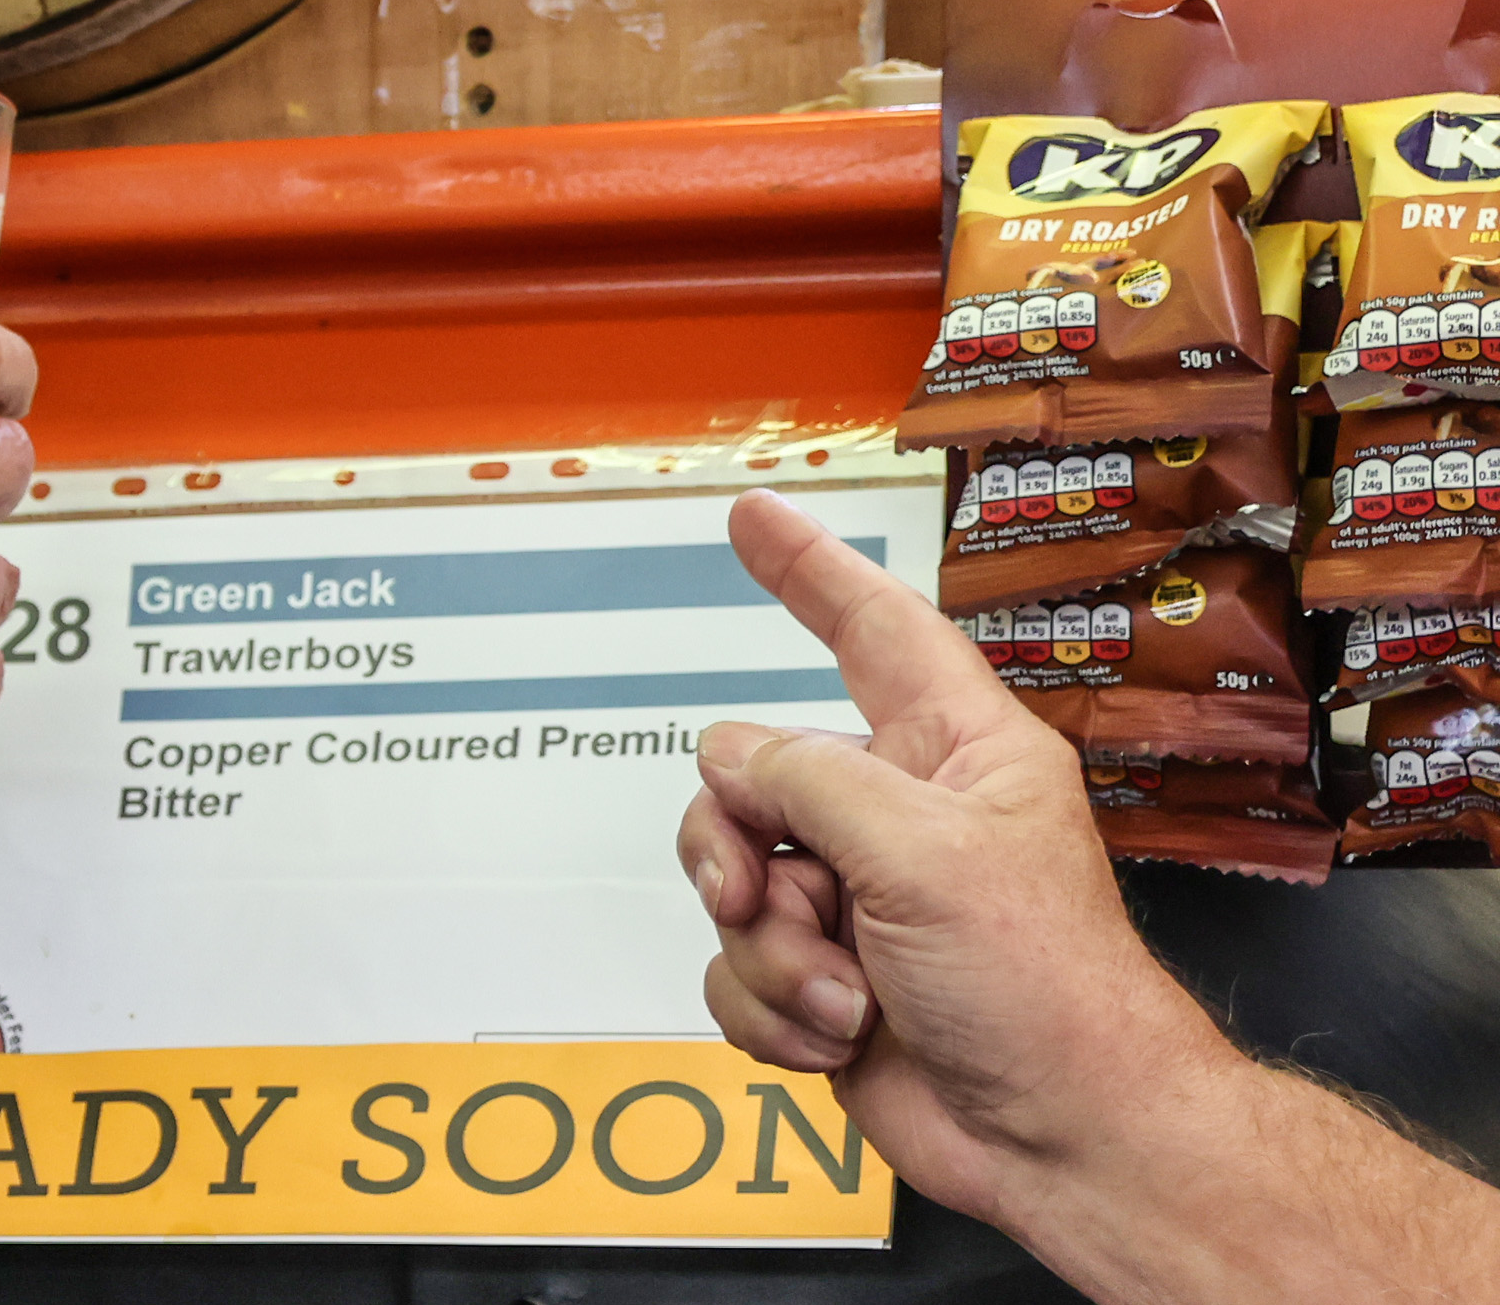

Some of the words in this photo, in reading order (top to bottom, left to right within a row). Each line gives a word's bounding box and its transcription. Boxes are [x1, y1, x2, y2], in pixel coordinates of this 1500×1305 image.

[1026, 134, 1204, 195] KP
[998, 218, 1065, 242] DRY
[1069, 193, 1190, 242] ROASTED
[1401, 202, 1467, 231] DRY
[1476, 206, 1500, 232] R
[1059, 238, 1130, 254] PEANUTS
[1468, 229, 1500, 244] PEA
[1360, 298, 1384, 311] Each
[1386, 296, 1407, 310] 50g
[1408, 292, 1435, 306] pack
[1436, 289, 1485, 303] contains
[1059, 310, 1093, 323] 0.85g
[1370, 320, 1385, 330] Fat
[1443, 311, 1474, 323] Sugars
[1366, 331, 1389, 344] 24g
[1405, 327, 1431, 340] 3.9g
[1178, 347, 1213, 371] 50g
[1329, 355, 1351, 369] 15%
[925, 380, 963, 395] Energy
[1380, 444, 1401, 457] 50g
[1430, 437, 1477, 451] contains
[1365, 469, 1379, 479] Fat
[1438, 460, 1469, 472] Sugars
[1360, 479, 1383, 492] 24g
[1399, 476, 1426, 489] 3.9g
[1441, 472, 1469, 485] 2.6g
[1409, 516, 1463, 532] reference
[958, 540, 996, 555] Energy
[1330, 537, 1370, 551] Energy
[1371, 535, 1390, 547] per
[135, 573, 273, 620] Green
[286, 569, 398, 611] Jack
[0, 597, 91, 663] 28
[1382, 624, 1405, 636] 24g
[132, 634, 415, 679] Trawlerboys
[1348, 649, 1371, 662] 15%
[1216, 671, 1250, 691] 50g
[1366, 670, 1379, 682] of
[123, 731, 291, 776] Copper
[304, 727, 529, 765] Coloured
[538, 721, 699, 758] Premiu
[117, 784, 243, 820] Bitter
[339, 1080, 864, 1198] SOON
